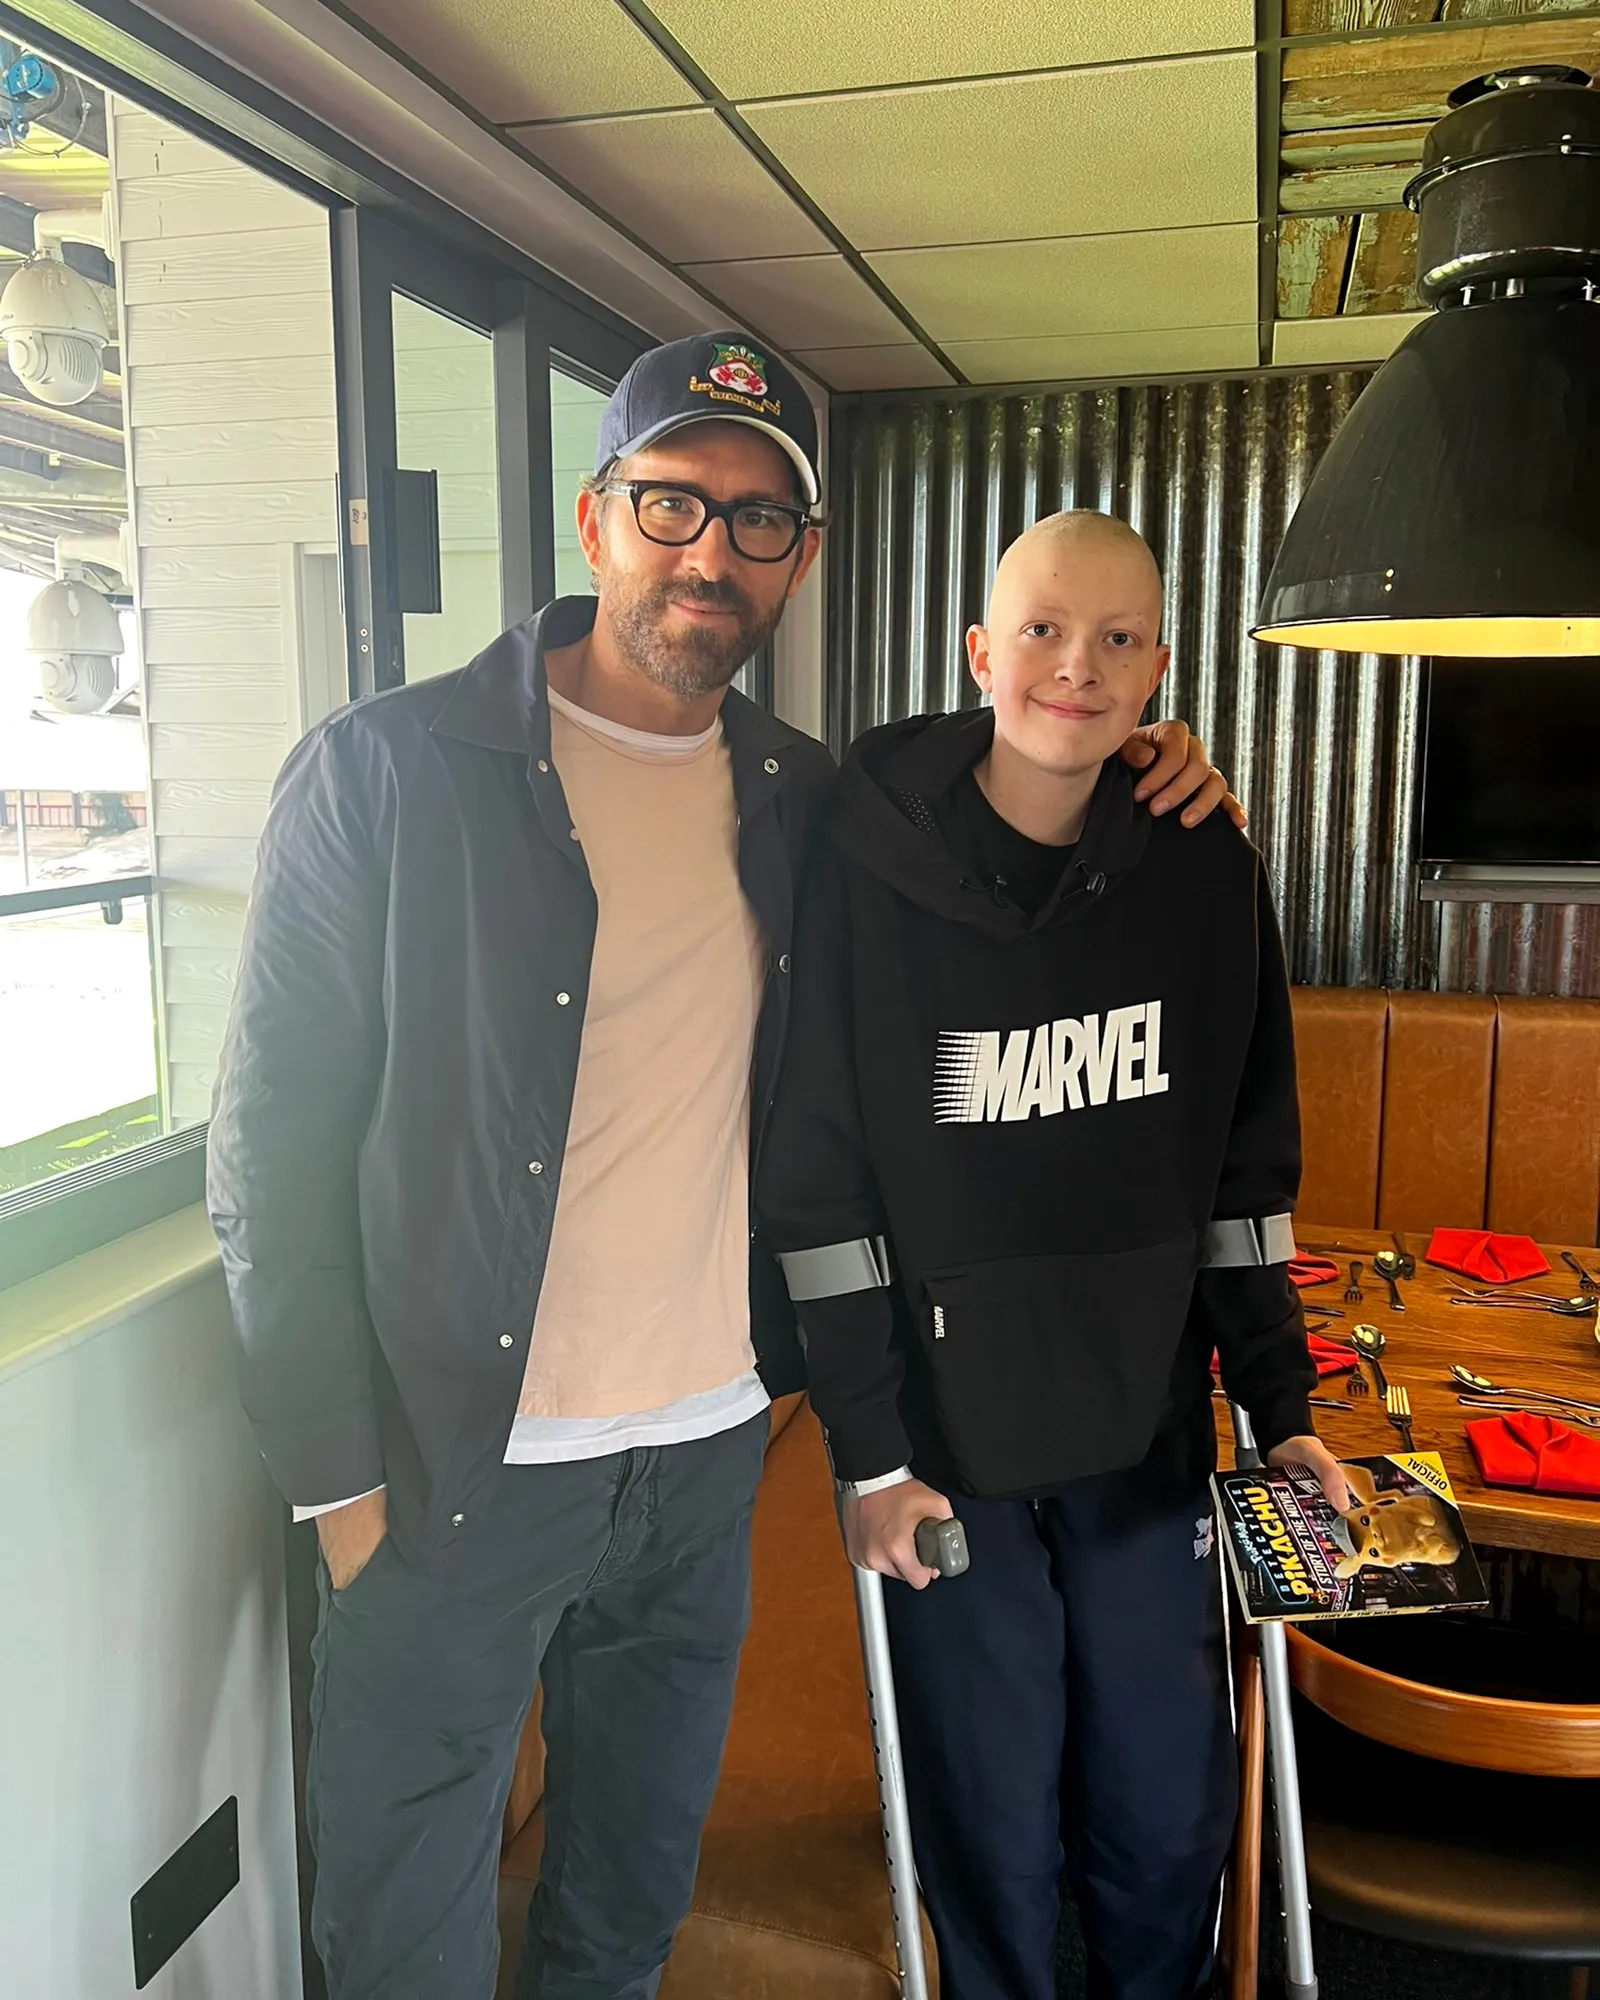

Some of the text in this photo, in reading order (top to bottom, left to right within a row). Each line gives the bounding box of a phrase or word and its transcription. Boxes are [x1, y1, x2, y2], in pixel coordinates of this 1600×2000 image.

[964, 1000, 1169, 1123] MARVEL
[934, 1305, 945, 1340] MARVEL
[1407, 1457, 1447, 1490] OFFICIAL
[1232, 1489, 1290, 1592] DETECTIVE
[1276, 1490, 1332, 1584] STORY OF THE MOVIE
